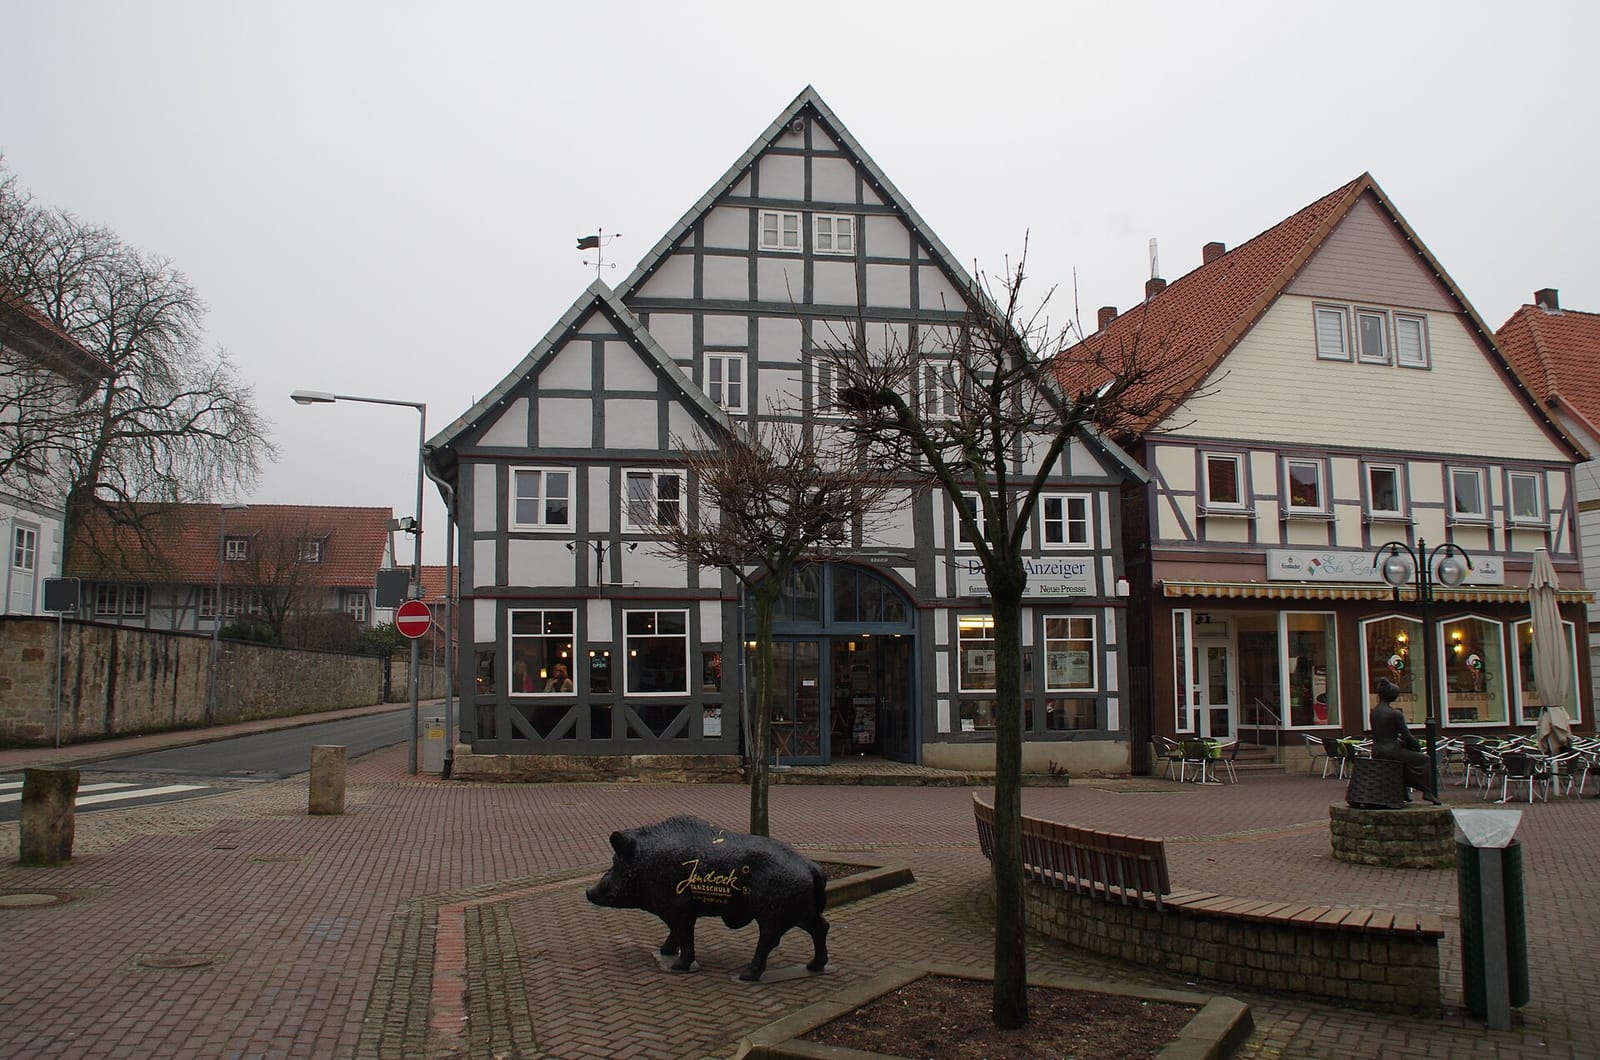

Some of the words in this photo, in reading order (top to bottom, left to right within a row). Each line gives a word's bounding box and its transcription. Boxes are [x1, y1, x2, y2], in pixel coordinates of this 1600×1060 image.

[1024, 559, 1086, 579] Anzeiger
[1040, 585, 1060, 593] Neue
[1060, 585, 1087, 593] Presse
[690, 884, 731, 893] TANZSCHULE
